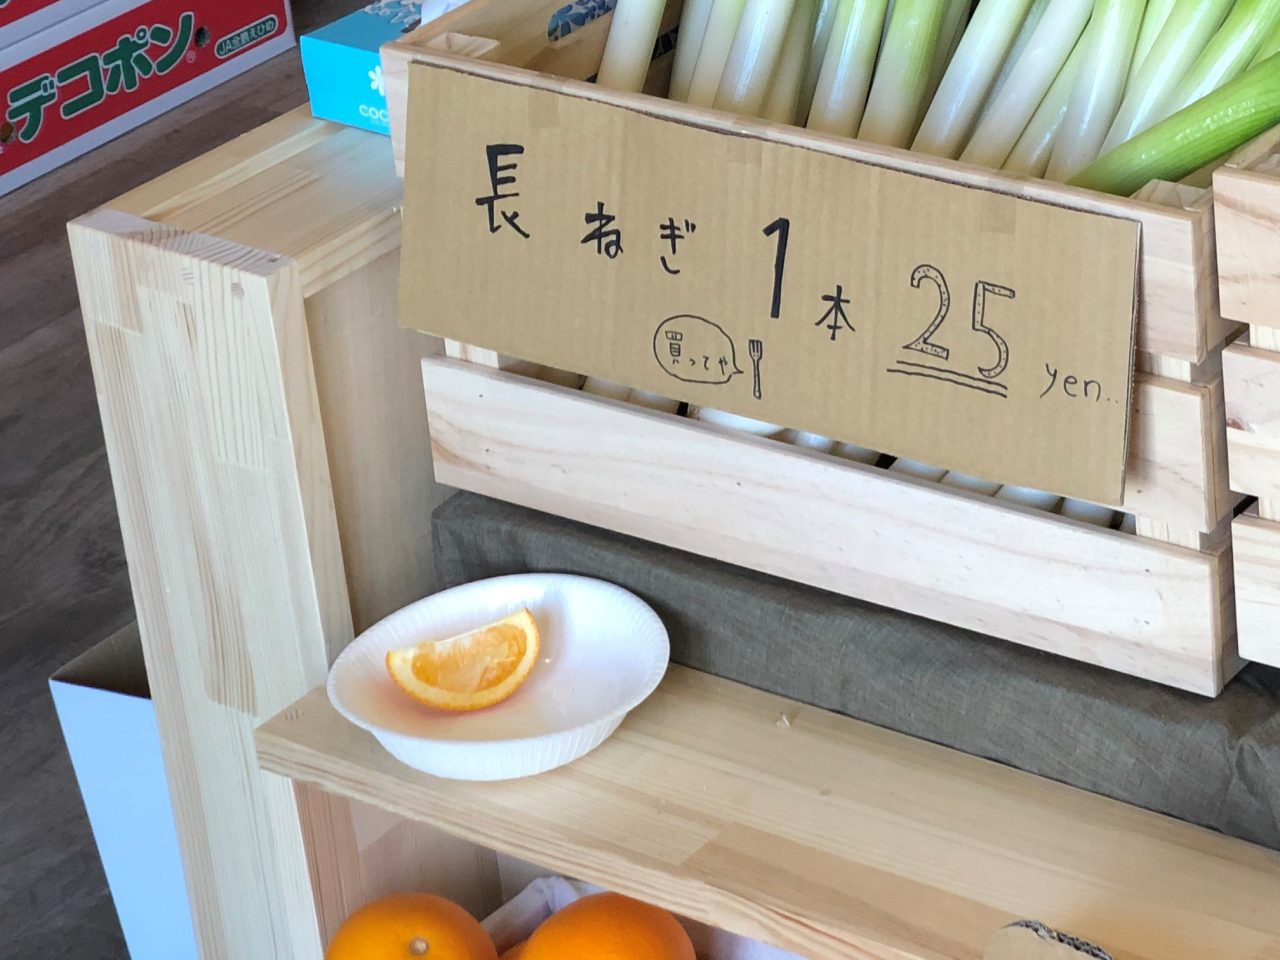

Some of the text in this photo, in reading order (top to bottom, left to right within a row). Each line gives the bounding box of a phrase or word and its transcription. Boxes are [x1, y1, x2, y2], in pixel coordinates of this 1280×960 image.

[7, 12, 195, 142] デコポン
[903, 264, 1016, 378] 25
